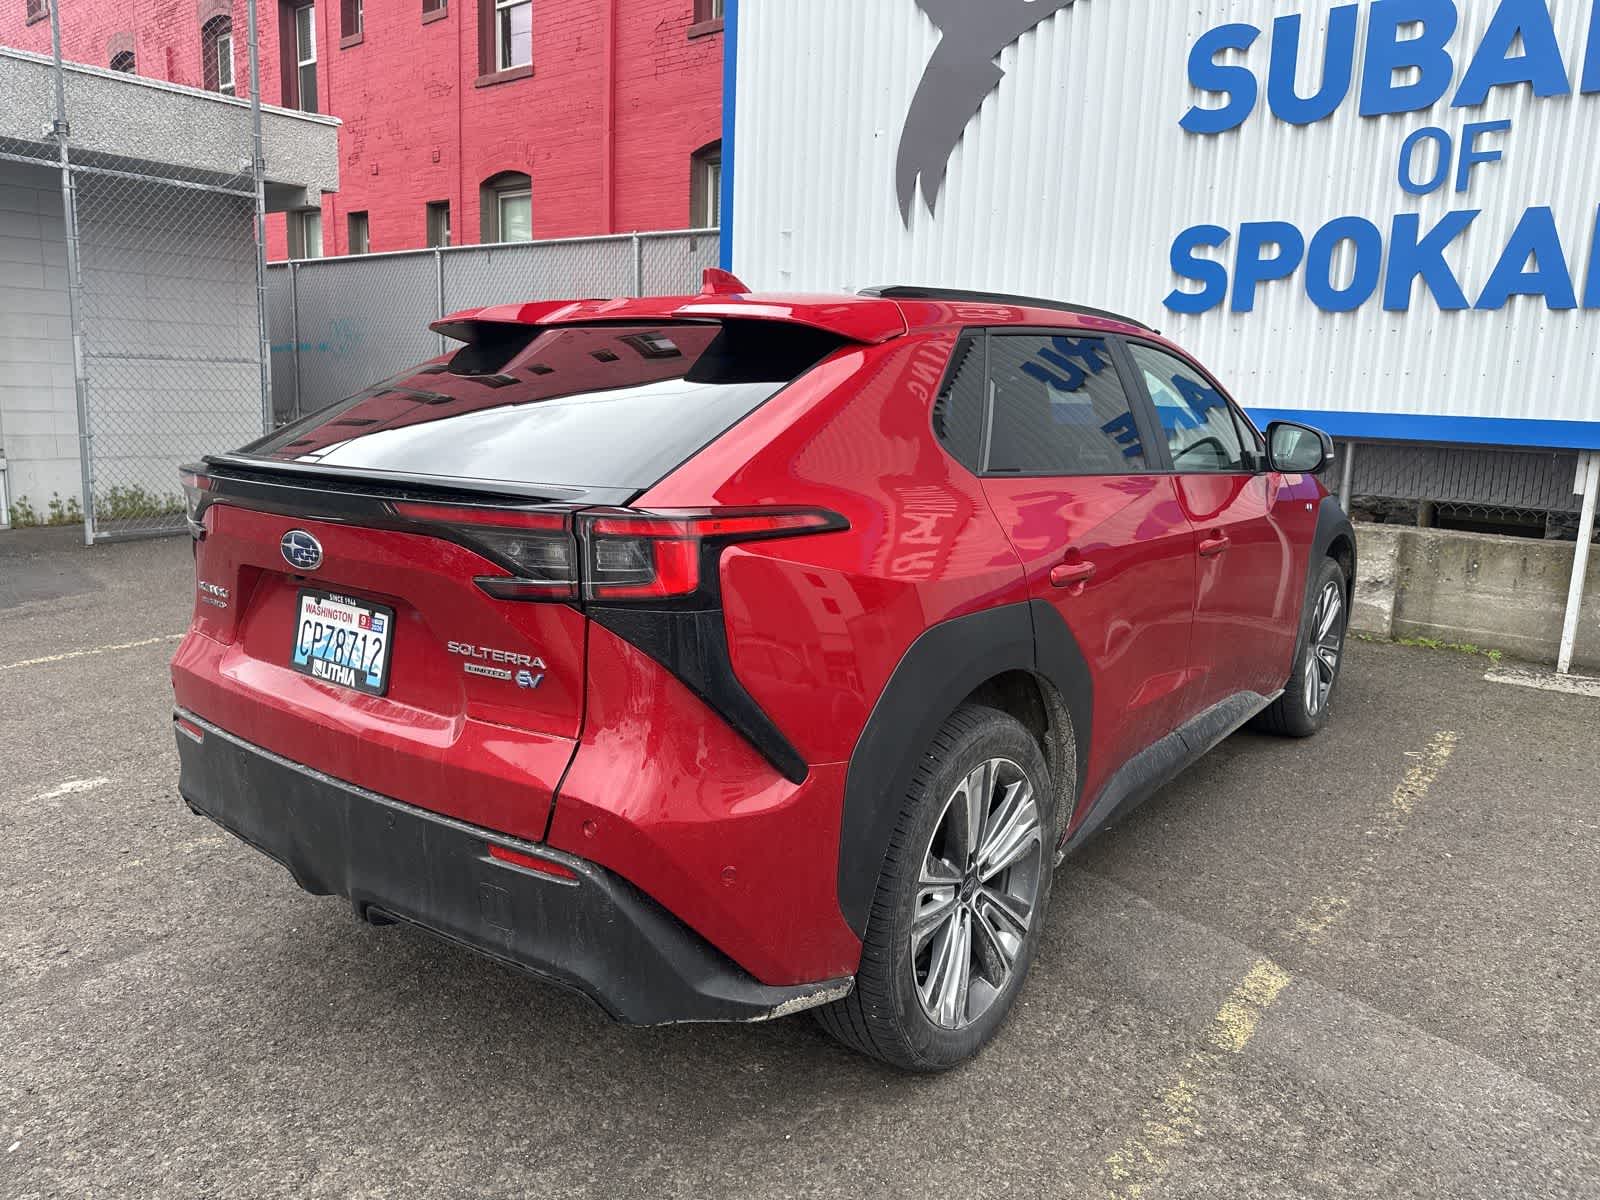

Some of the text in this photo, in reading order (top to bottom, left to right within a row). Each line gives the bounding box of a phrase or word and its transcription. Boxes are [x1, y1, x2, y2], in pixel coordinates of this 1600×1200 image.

[1178, 0, 1600, 134] SUBA
[1397, 119, 1512, 195] OF
[1162, 203, 1600, 314] SPOKA
[329, 593, 343, 604] SINCE
[305, 603, 353, 623] WASHINGTON
[299, 619, 383, 677] CP78712
[447, 640, 547, 669] SOLTERRA
[322, 662, 356, 687] LITHIA
[468, 666, 507, 679] LIMITED
[515, 669, 545, 689] EV
